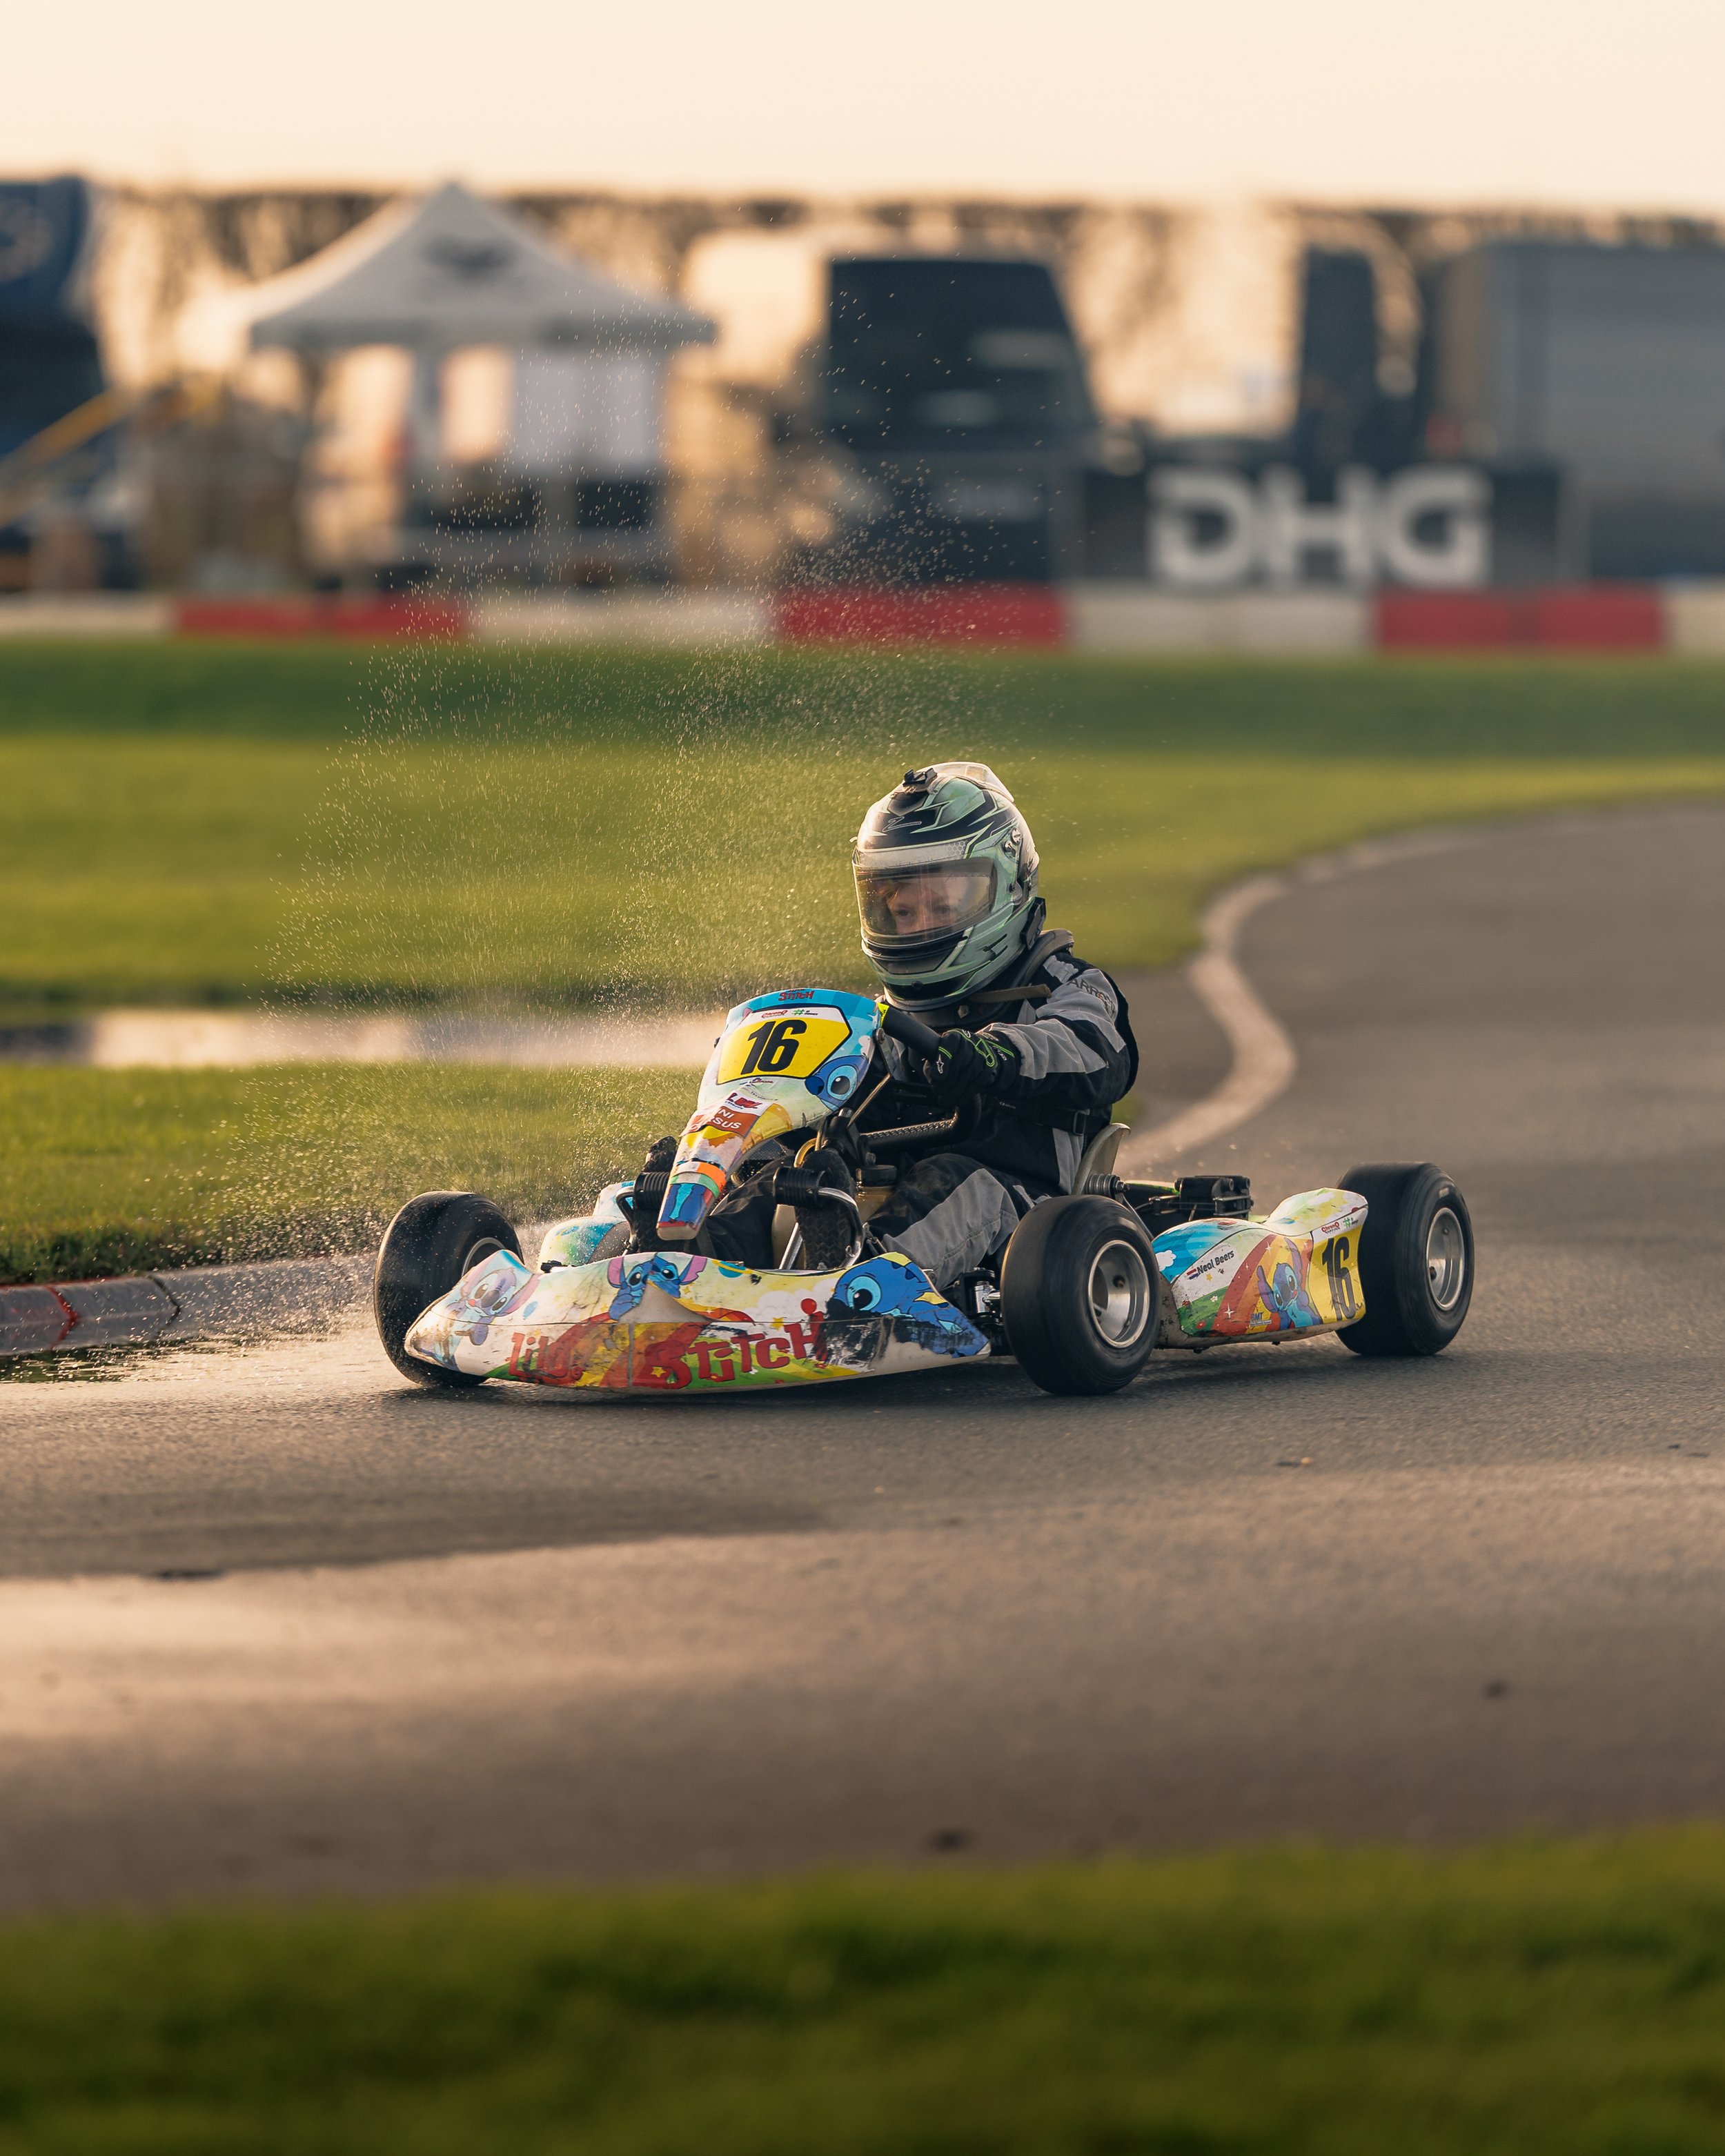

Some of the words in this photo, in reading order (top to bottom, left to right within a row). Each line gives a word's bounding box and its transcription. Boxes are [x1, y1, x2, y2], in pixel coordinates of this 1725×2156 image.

[1148, 466, 1492, 588] DHG
[740, 1020, 807, 1075] 16
[1196, 1259, 1214, 1275] Neal
[1214, 1250, 1234, 1266] Beers
[1322, 1236, 1355, 1321] 16
